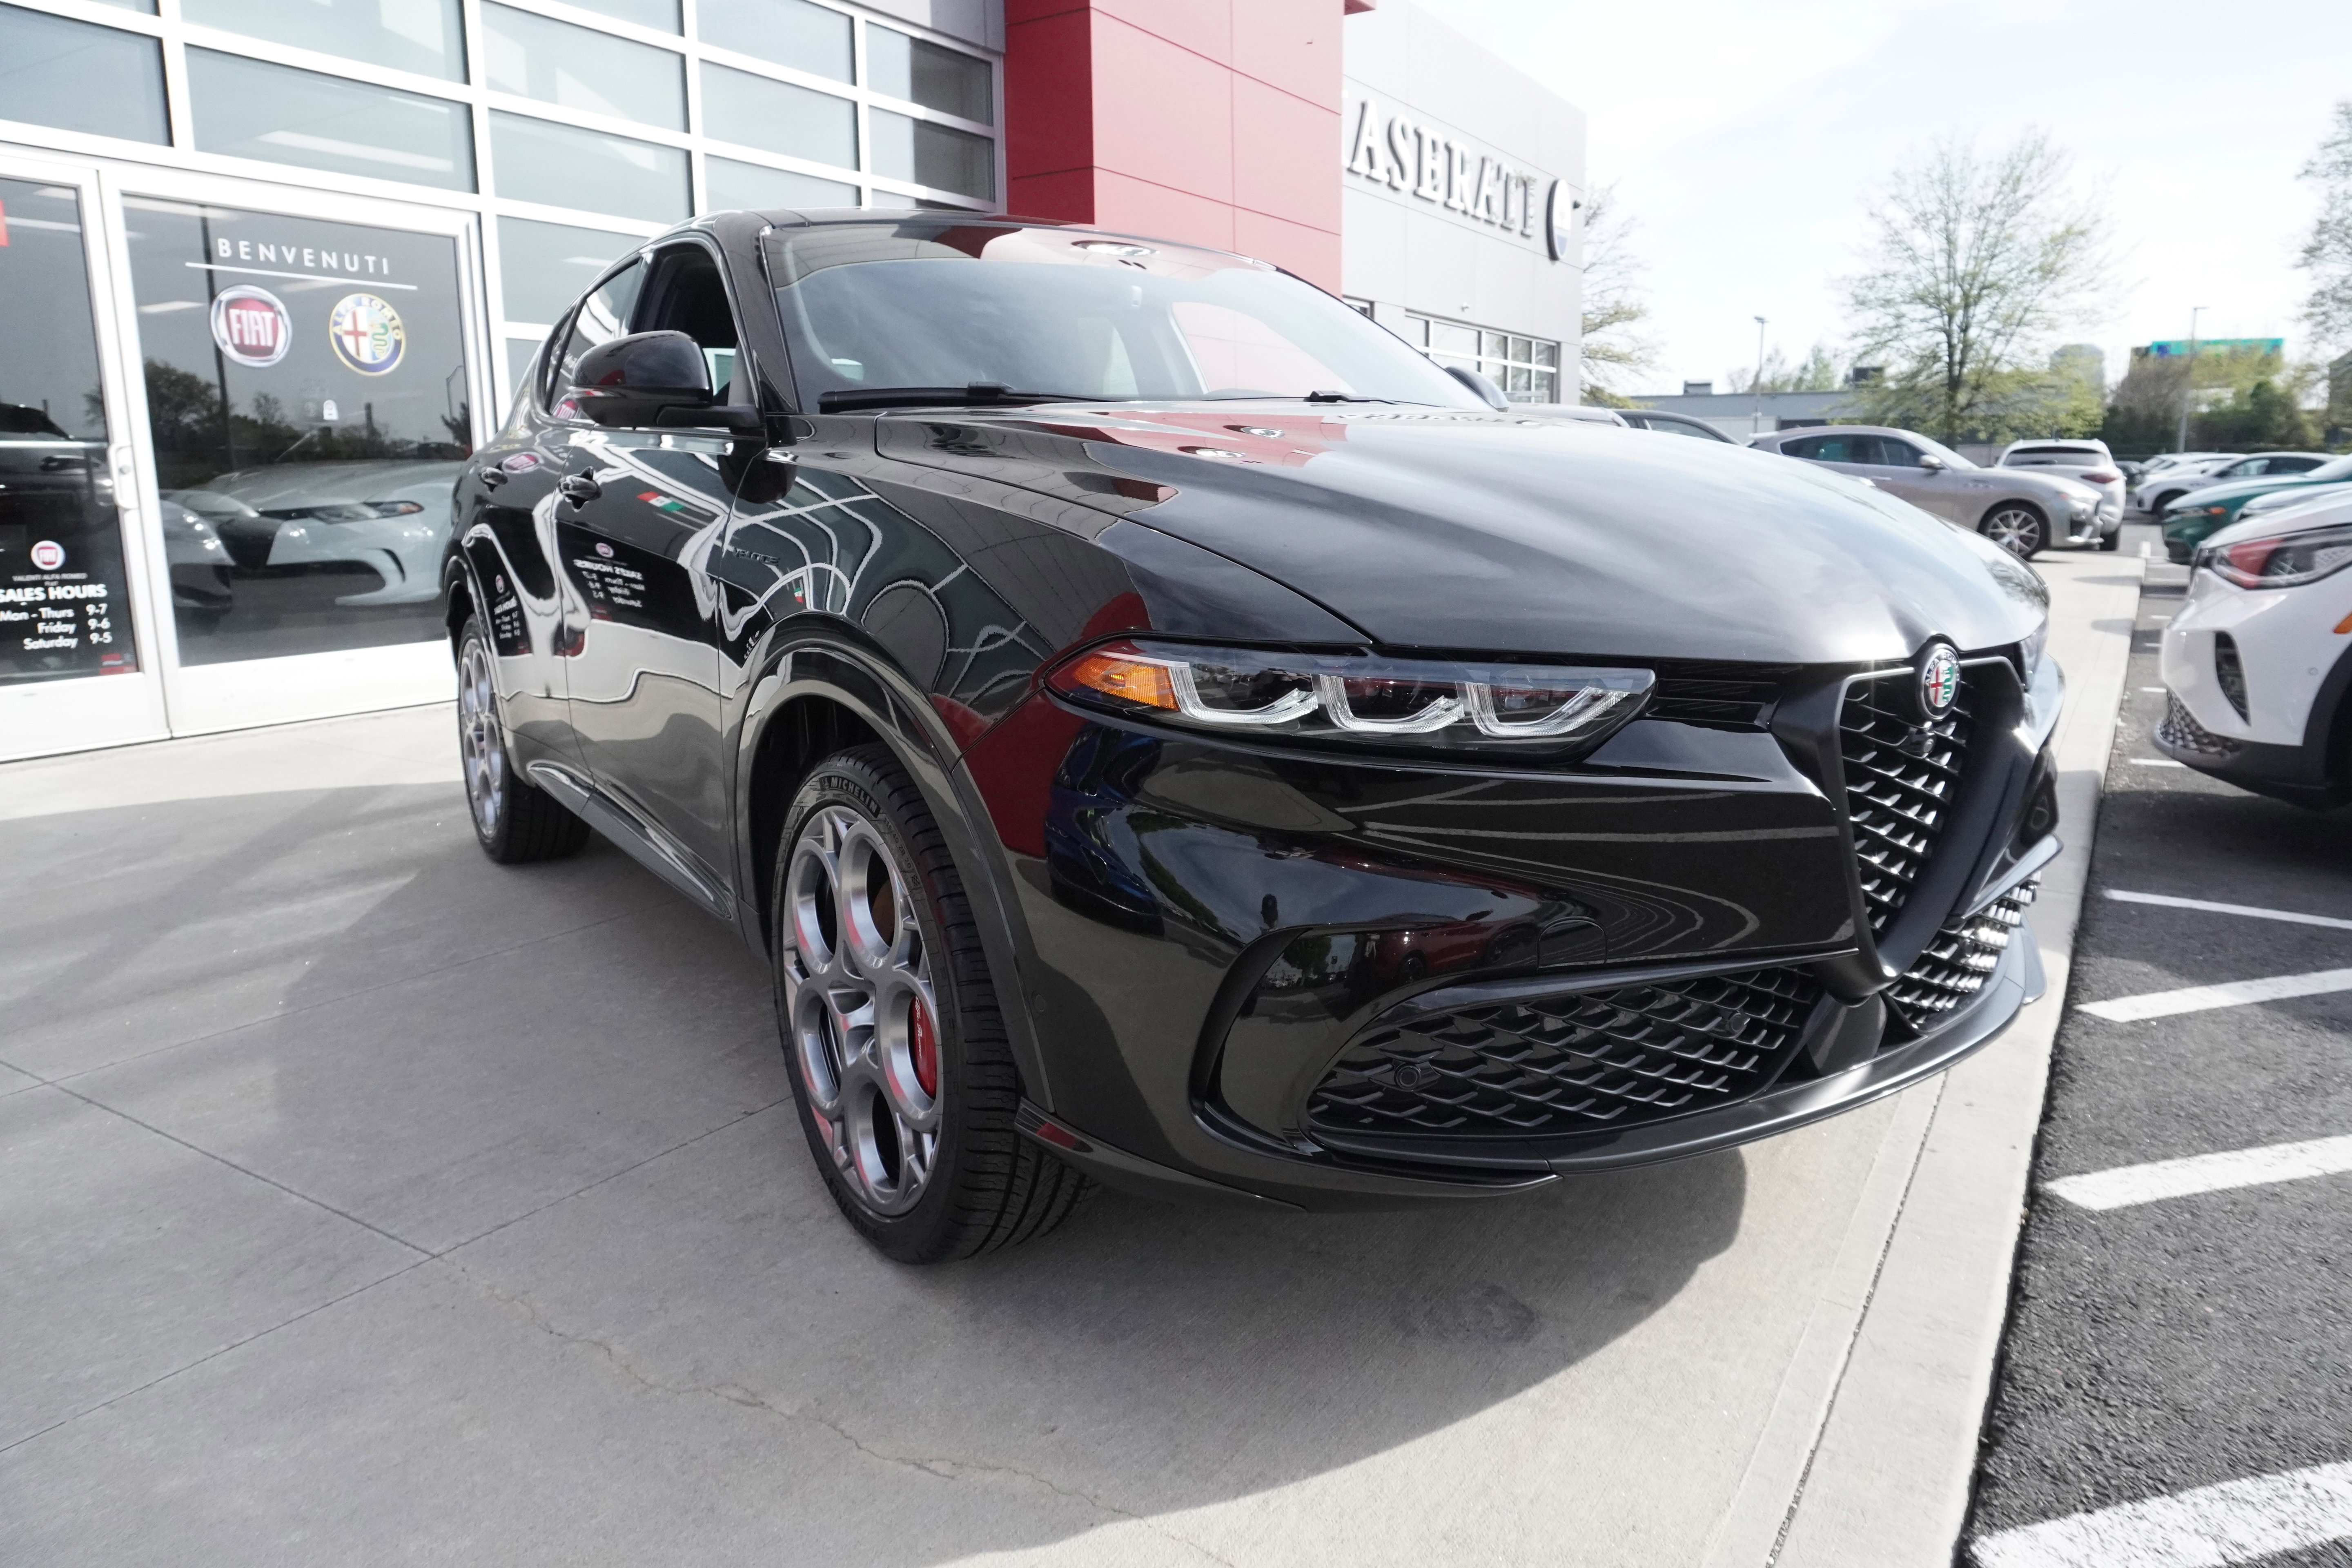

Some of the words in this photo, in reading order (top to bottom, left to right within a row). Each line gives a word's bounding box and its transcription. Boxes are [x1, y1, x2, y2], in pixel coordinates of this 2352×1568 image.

[1342, 89, 1537, 239] ASERATI
[217, 238, 388, 274] BENVENUTI
[229, 308, 275, 347] FIAT
[332, 300, 357, 335] ALFA
[361, 296, 402, 340] ROMEO
[48, 584, 107, 599] HOURS
[0, 610, 29, 621] Mon
[38, 607, 74, 619] Thurs
[86, 603, 108, 616] 9-7
[37, 621, 77, 634] Friday
[88, 617, 111, 630] 9-6
[23, 635, 78, 650] Saturday
[89, 632, 113, 644] 9-5
[831, 776, 878, 813] MICHELIN
